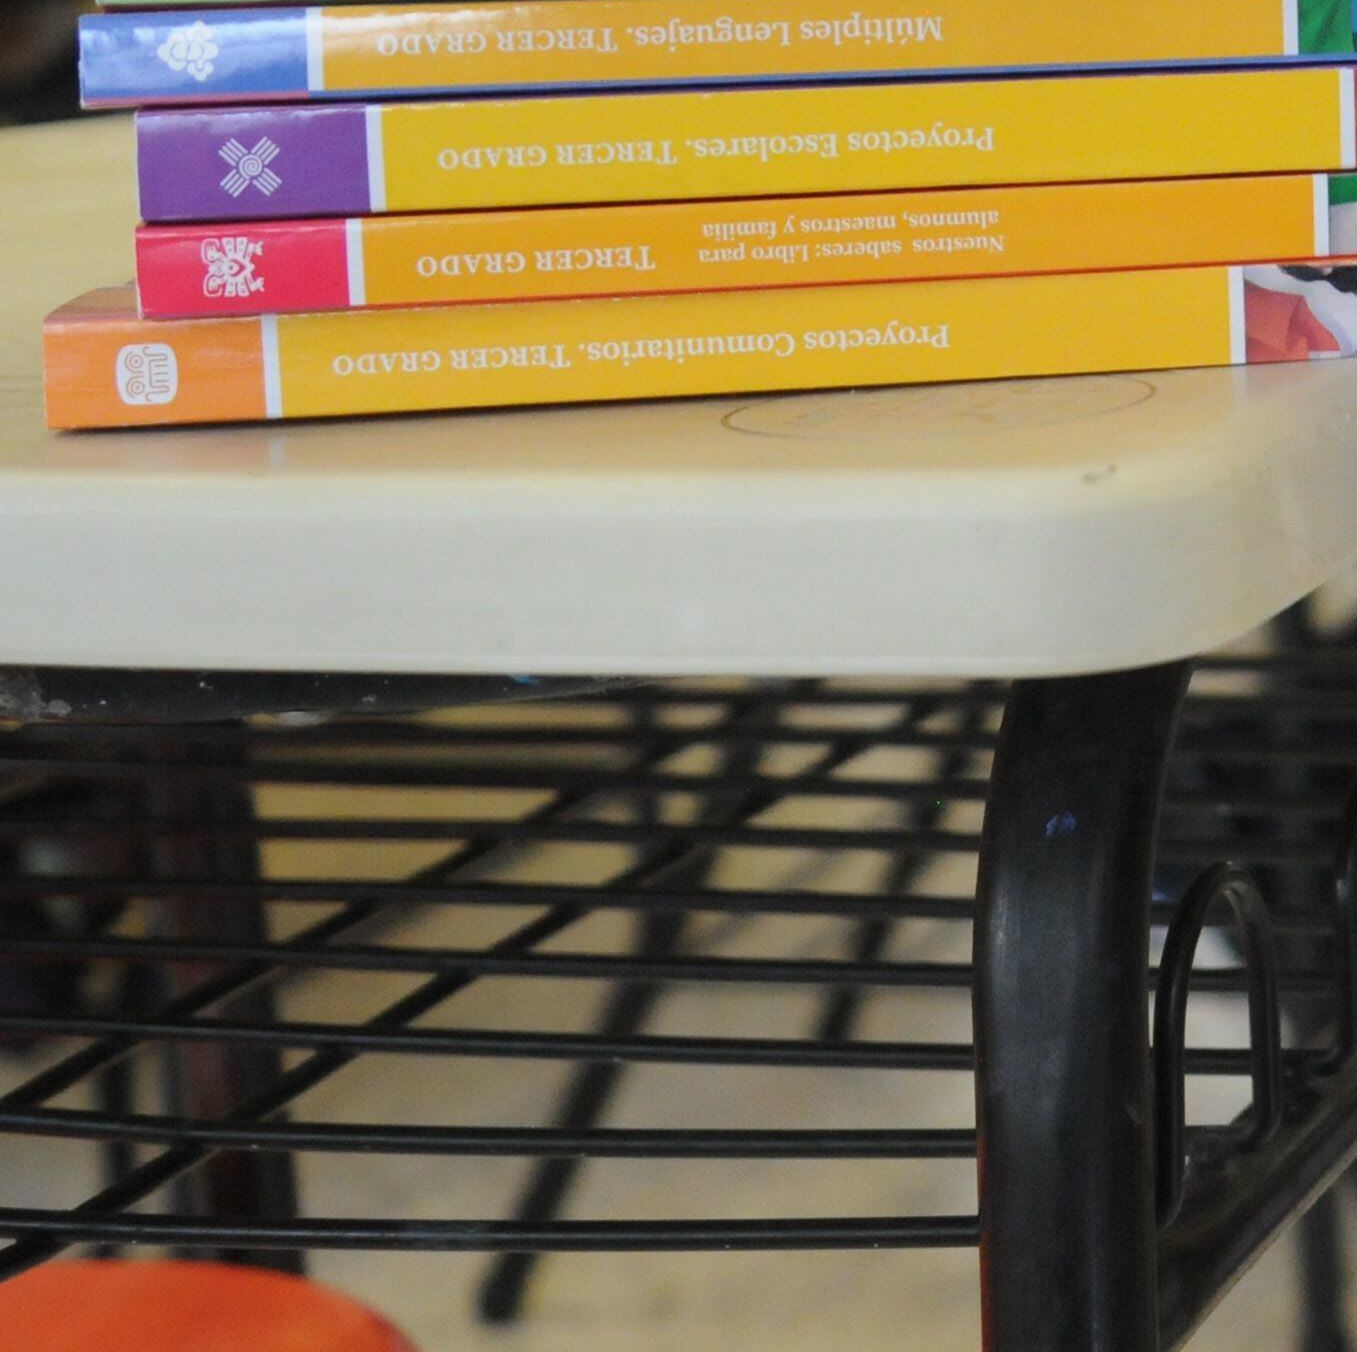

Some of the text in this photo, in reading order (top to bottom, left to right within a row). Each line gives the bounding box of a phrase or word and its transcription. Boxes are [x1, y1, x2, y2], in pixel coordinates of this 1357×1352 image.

[376, 12, 943, 56] Múltiples Lenguajes. TERCER GRADO
[437, 123, 995, 170] Proyectos Escolares. TERCER GRADO
[702, 210, 999, 241] alumnos, maestros y familia
[416, 246, 655, 277] TERCER GRADO
[699, 236, 1004, 264] Nuestros saberes: Libro para
[332, 320, 949, 376] Proyectos Comunitarios. TERCER GRADO
